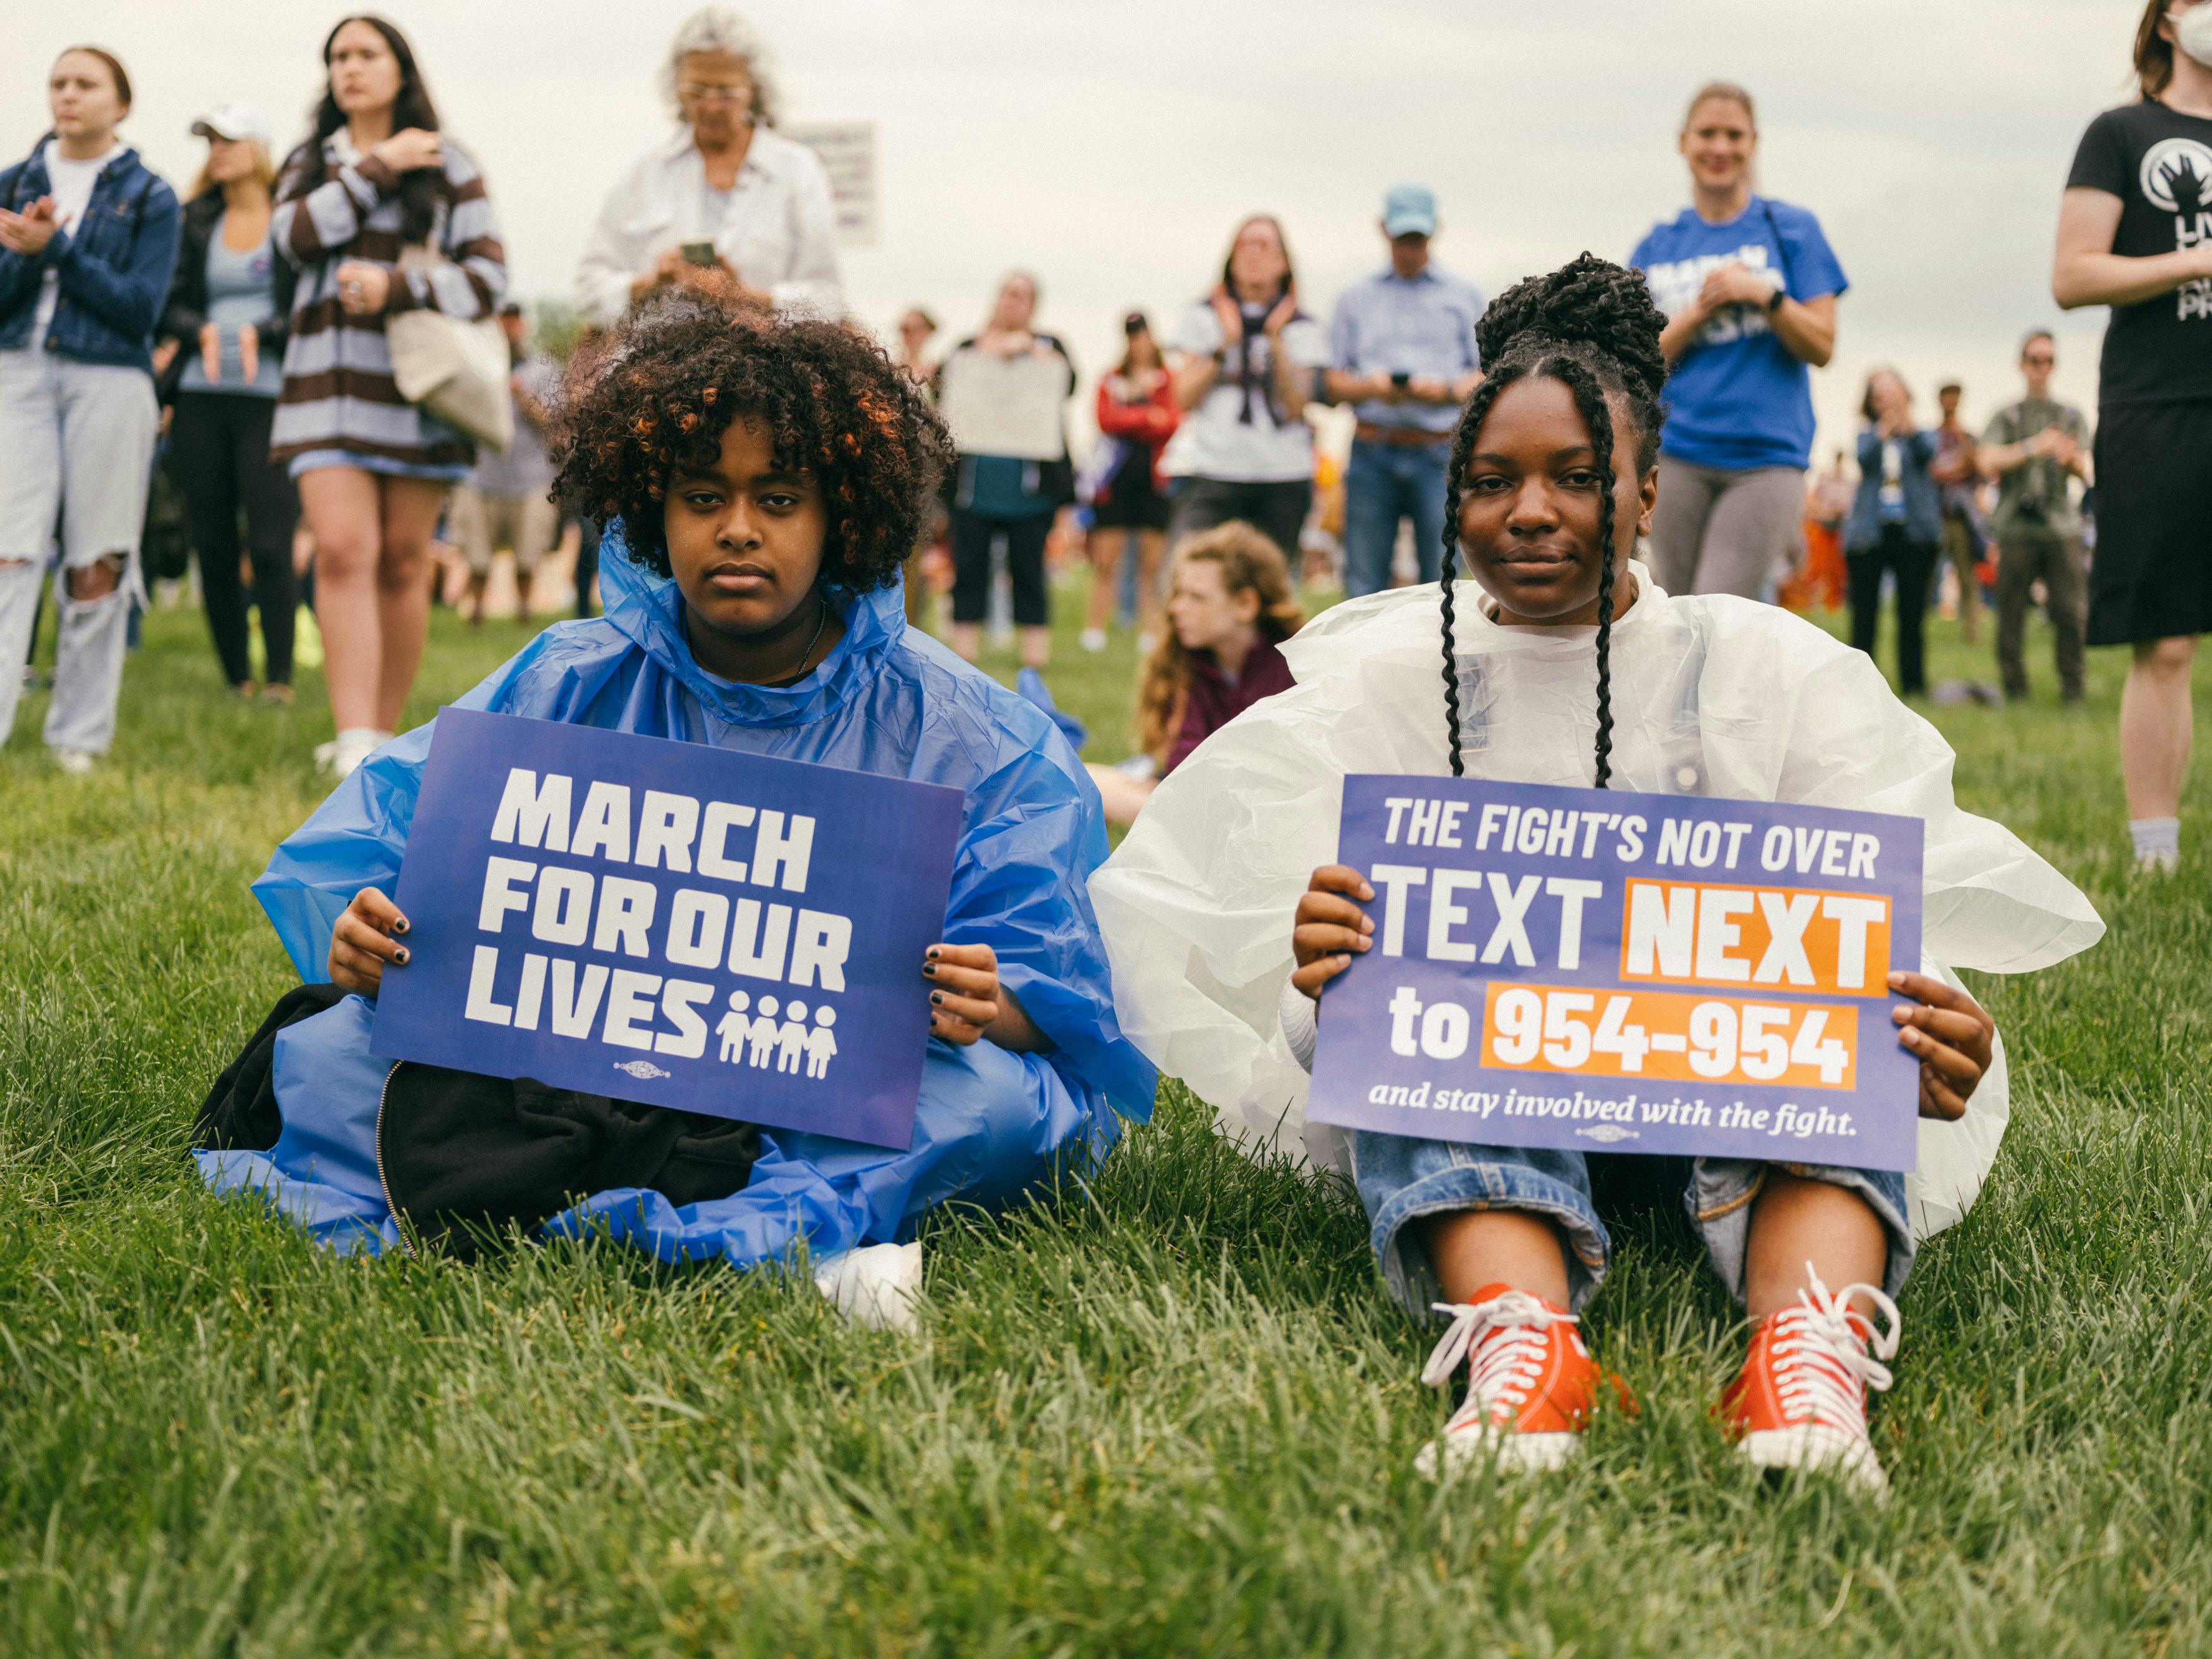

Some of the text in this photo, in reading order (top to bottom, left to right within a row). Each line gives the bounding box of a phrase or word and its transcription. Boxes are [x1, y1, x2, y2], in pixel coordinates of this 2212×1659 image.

[490, 767, 816, 893] MARCH
[1384, 798, 1881, 880] THE FIGHT'S NOT OVER
[478, 856, 853, 993] FOR OUR
[1370, 863, 1886, 988] TEXT NEXT
[465, 945, 715, 1059] LIVES
[1388, 986, 1849, 1085] to 954-954
[1368, 1081, 1858, 1138] and stay involved with the fight.
